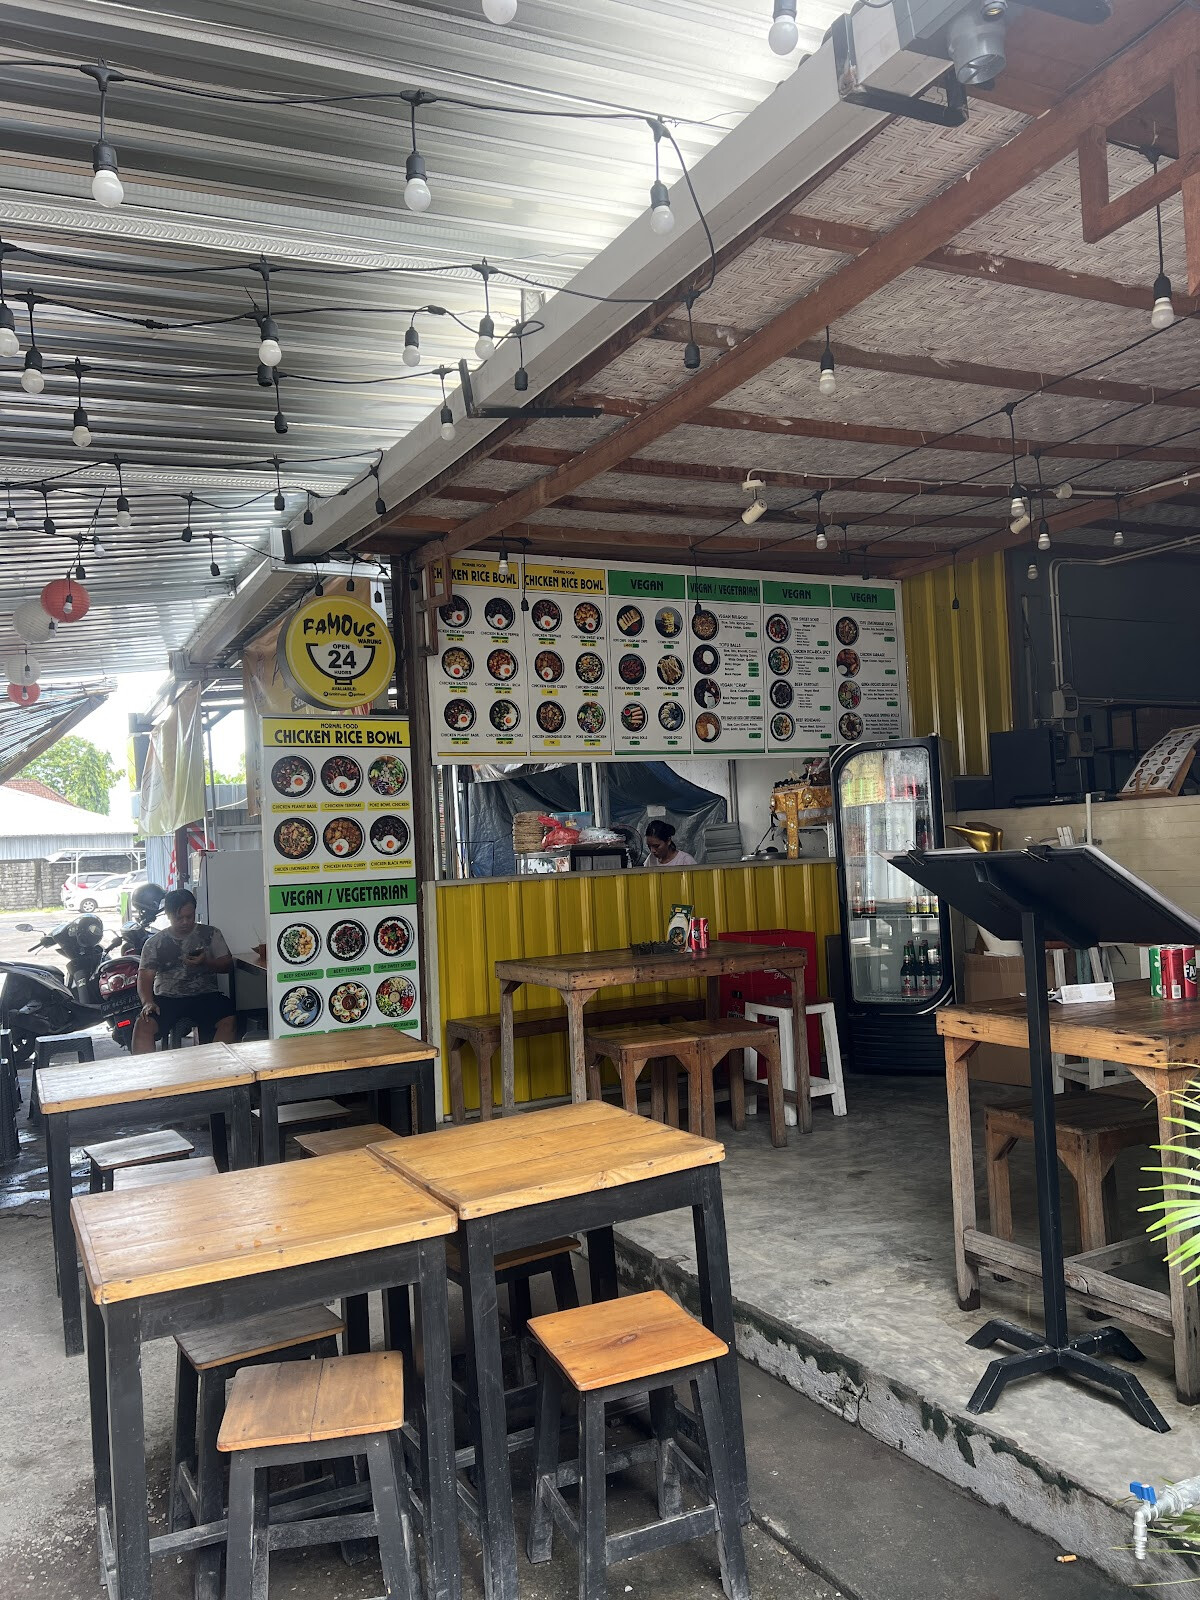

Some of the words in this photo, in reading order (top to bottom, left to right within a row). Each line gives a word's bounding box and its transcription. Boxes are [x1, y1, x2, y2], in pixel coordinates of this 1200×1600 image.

[471, 570, 490, 582] RICE
[492, 572, 517, 585] BOWL
[525, 574, 559, 587] CHICKEN
[561, 577, 578, 589] RICE
[581, 578, 604, 591] BOWL
[630, 579, 664, 591] VEGAN
[690, 582, 712, 594] VEGAN
[719, 584, 758, 596] VEGETARIAN
[782, 588, 812, 600] VEGAN
[850, 592, 878, 603] VEGAN
[303, 612, 376, 637] FAMOUS
[328, 650, 357, 669] 24
[274, 730, 331, 744] CHICKEN
[335, 730, 363, 744] RICE
[367, 730, 403, 745] BOWL
[281, 889, 323, 907] VEGAN
[327, 888, 332, 904] /
[336, 884, 408, 903] VEGETARIAN
